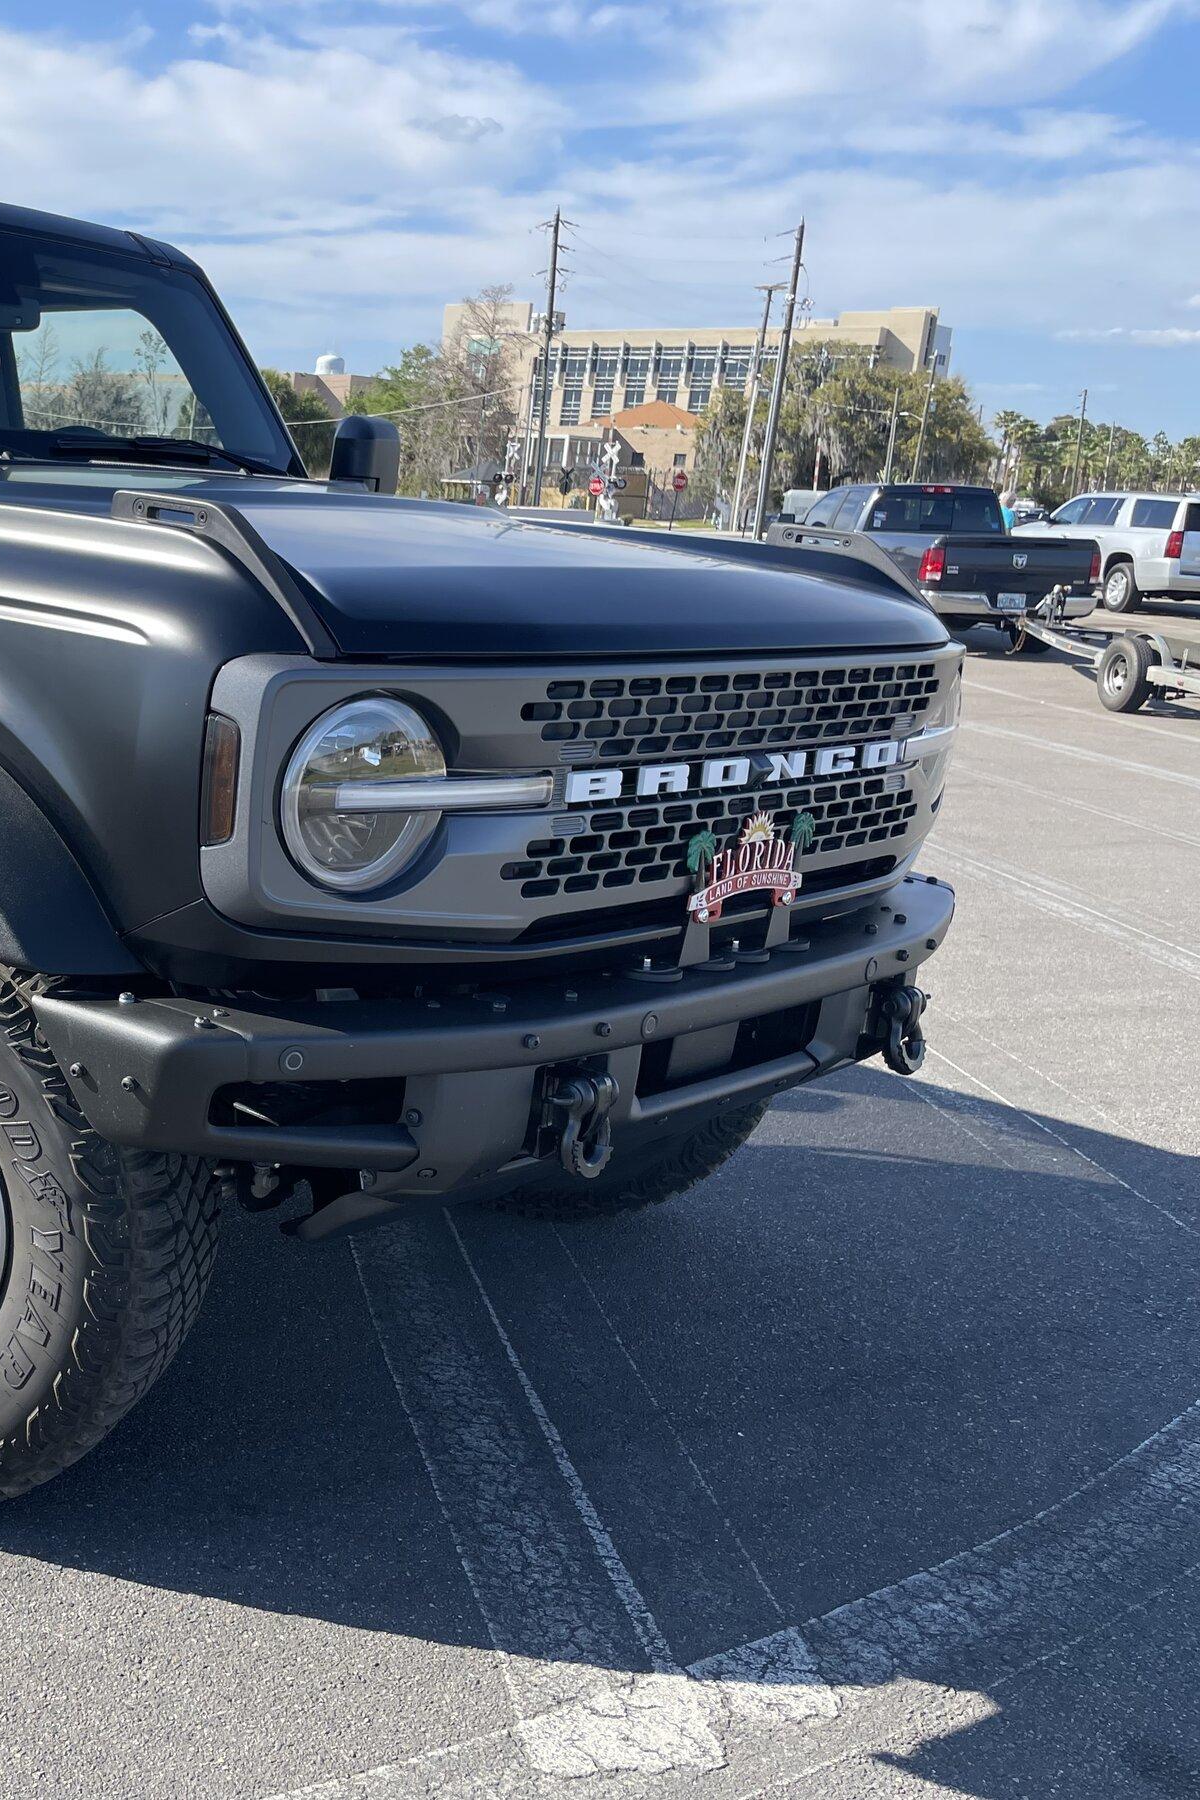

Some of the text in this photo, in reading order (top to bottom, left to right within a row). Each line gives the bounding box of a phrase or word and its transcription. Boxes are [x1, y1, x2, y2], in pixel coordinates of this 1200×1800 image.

[565, 741, 901, 803] BRONCO
[712, 839, 795, 885] FLORIDA
[709, 873, 789, 901] LAND OF SUNSHINE
